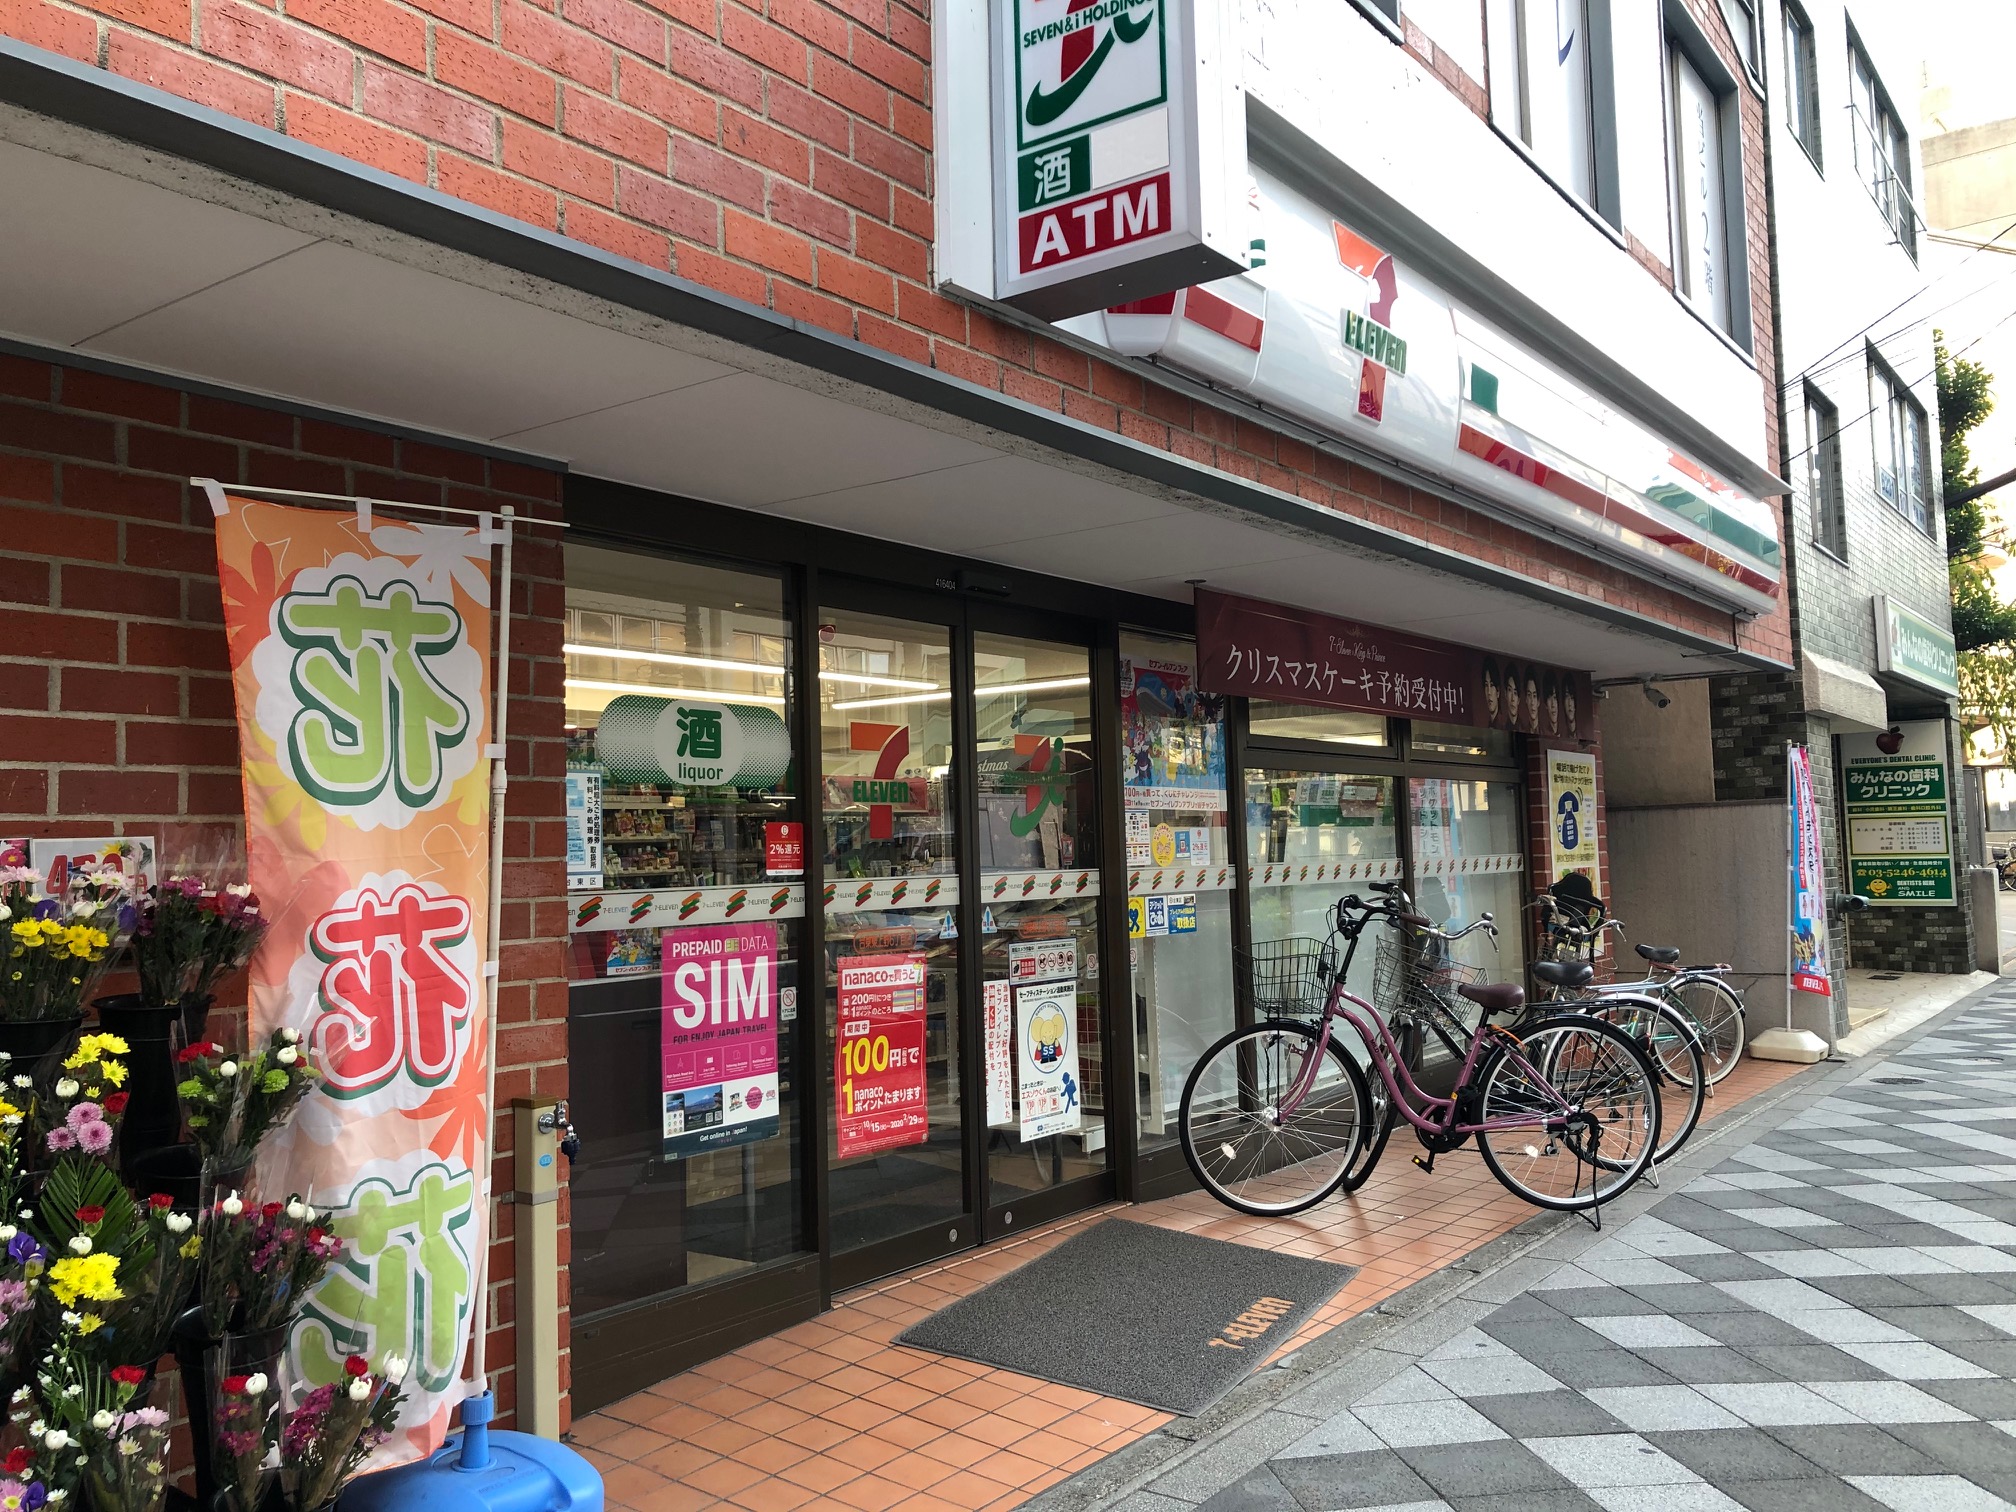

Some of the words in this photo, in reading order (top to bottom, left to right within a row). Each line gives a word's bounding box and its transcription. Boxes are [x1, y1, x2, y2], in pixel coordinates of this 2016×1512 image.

[1083, 0, 1150, 26] HOLDIN
[1034, 147, 1072, 203] 酒
[1032, 182, 1159, 265] ATM
[1371, 645, 1386, 662] Prince
[1226, 643, 1465, 714] クリスマスケーキ予約受付中!
[676, 706, 722, 759] 酒
[1890, 755, 1913, 763] DENTAL
[678, 762, 724, 782] liquor
[1850, 768, 1940, 784] みんなの歯科
[1860, 784, 1931, 798] クリニック
[769, 844, 801, 855] 2%還元
[1868, 867, 1947, 878] 03-5246-4614
[1176, 917, 1196, 929] 取扱店
[672, 939, 722, 958] PREPAID
[741, 935, 769, 952] DATA
[844, 968, 915, 986] nanacoで買うと
[673, 956, 769, 1029] SIM
[673, 1035, 690, 1045] FOR
[691, 1031, 715, 1042] ENJOY
[718, 1027, 740, 1038] JAPAN
[743, 1023, 767, 1034] TRAVEL
[846, 1023, 868, 1034] 期間中
[1042, 1044, 1055, 1055] SS
[843, 1078, 853, 1115] 1
[854, 1086, 884, 1101] nanaco
[884, 1086, 921, 1105] たまります
[854, 1098, 884, 1113] ポイント
[700, 1134, 709, 1142] Get
[709, 1131, 725, 1140] online
[731, 1126, 748, 1136] Japan!
